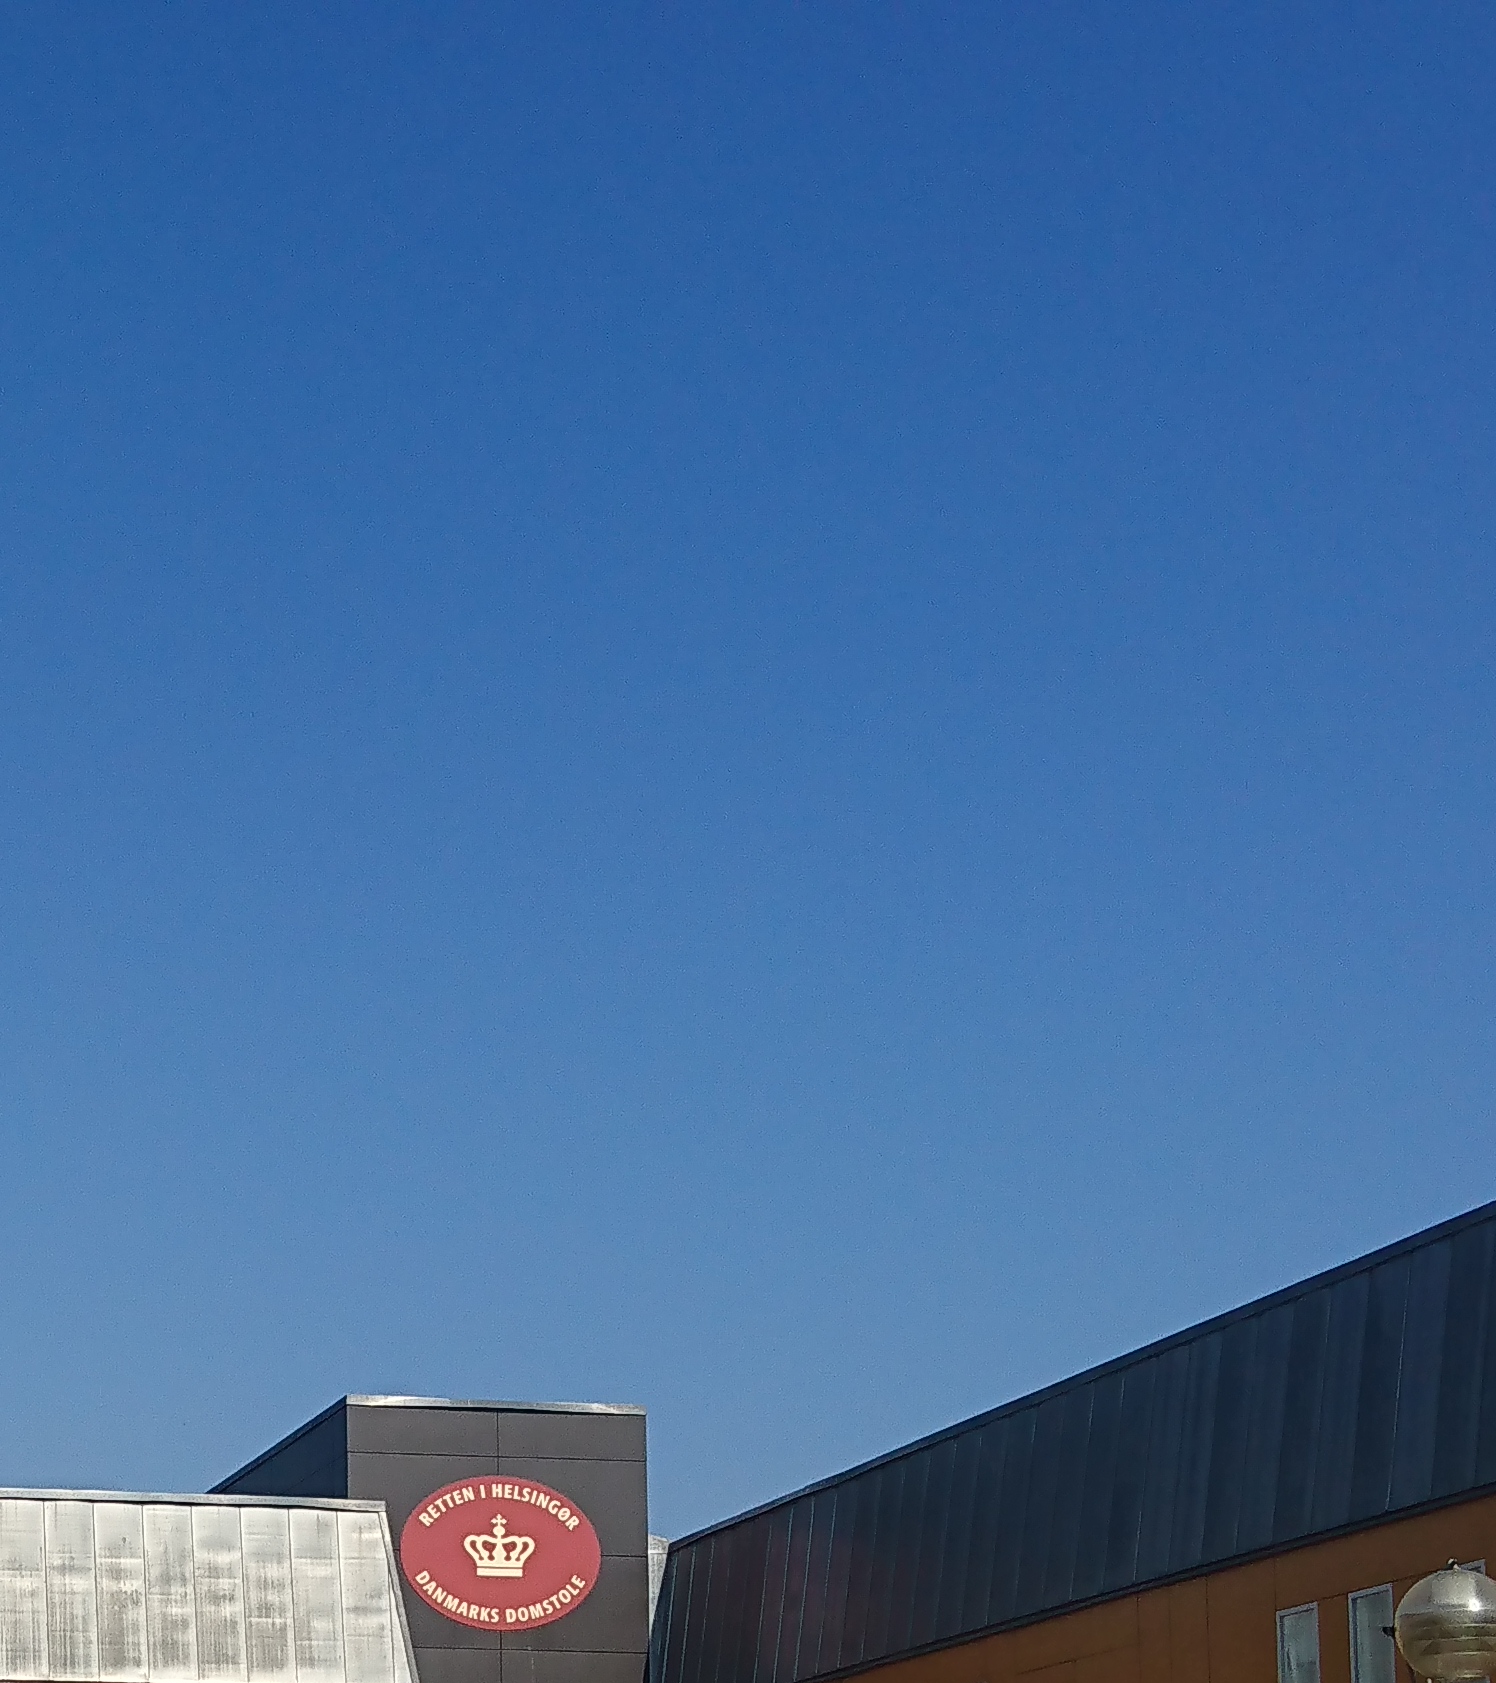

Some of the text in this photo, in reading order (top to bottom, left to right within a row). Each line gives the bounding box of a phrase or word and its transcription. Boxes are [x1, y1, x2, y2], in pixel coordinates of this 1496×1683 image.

[418, 1483, 581, 1531] RETTEN I HELSINGØR
[415, 1570, 586, 1624] DANMARKS DOMSTOLE
